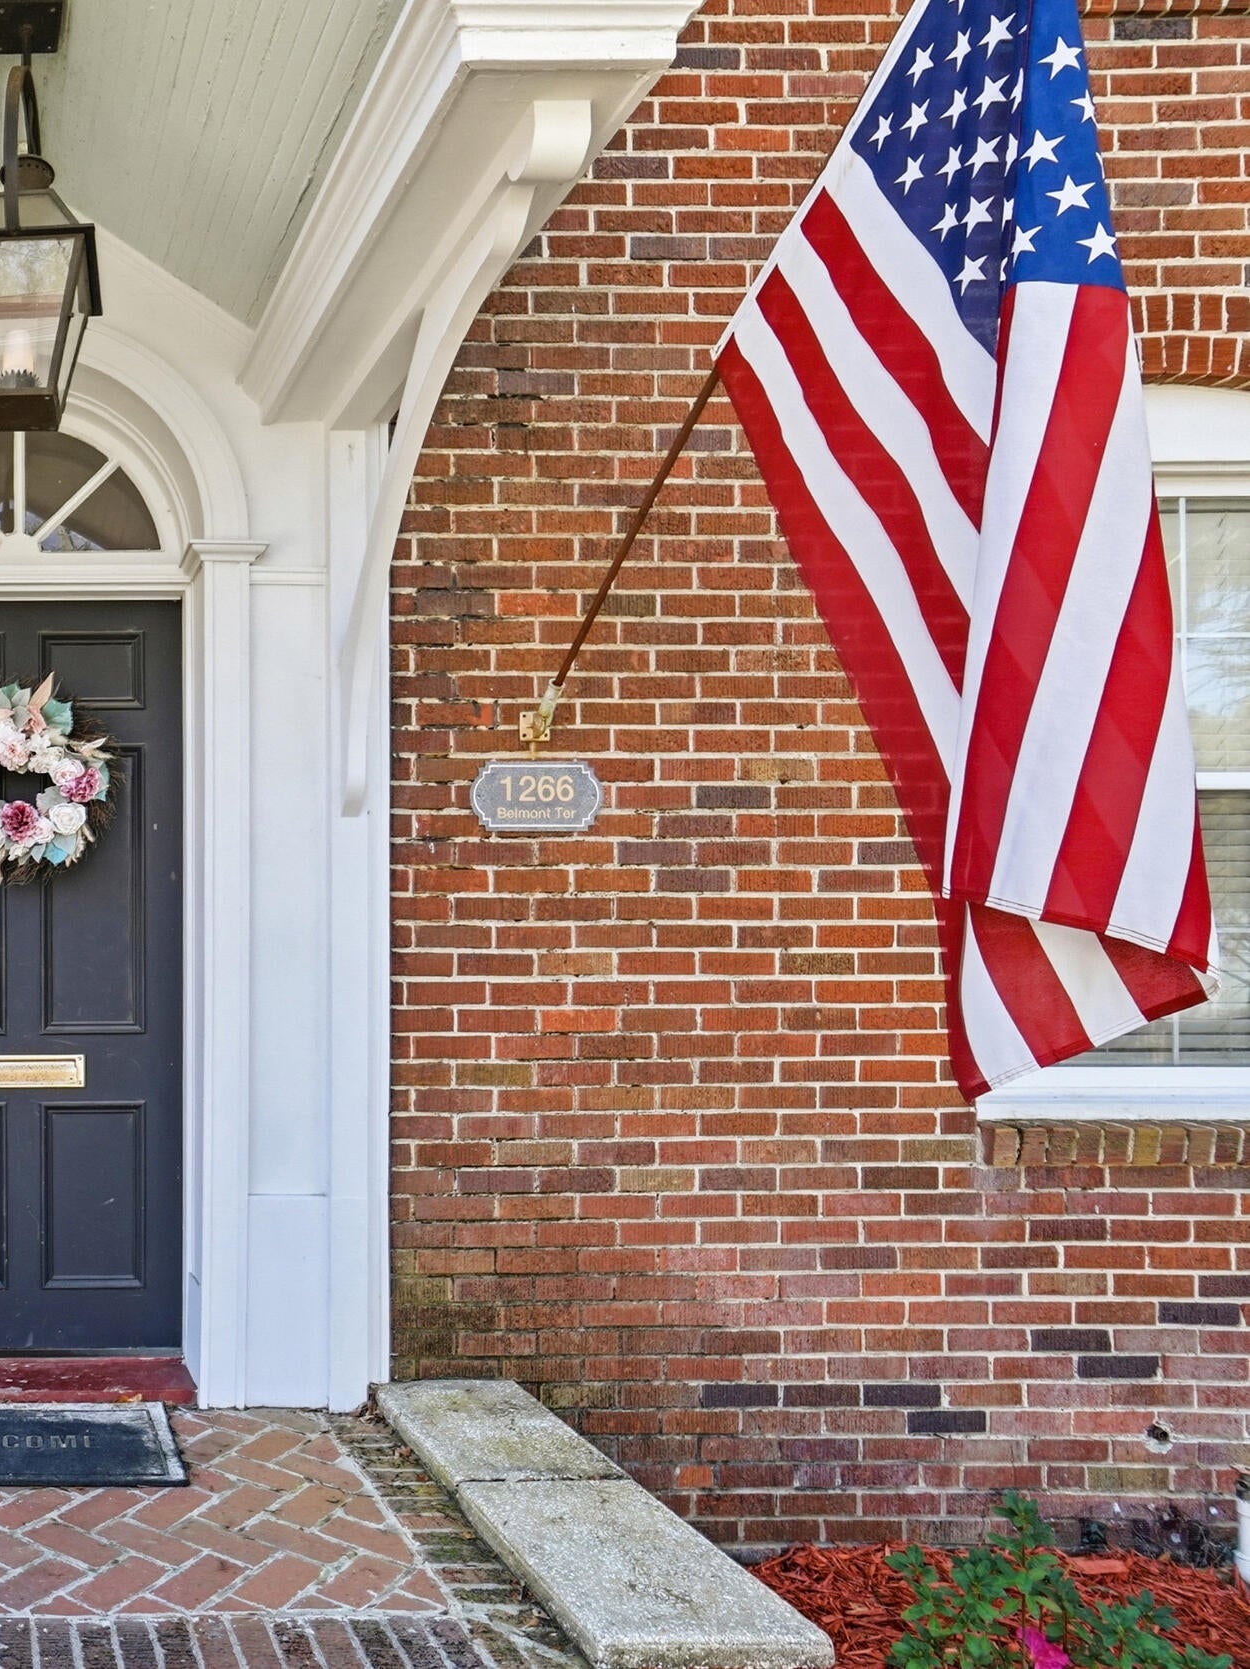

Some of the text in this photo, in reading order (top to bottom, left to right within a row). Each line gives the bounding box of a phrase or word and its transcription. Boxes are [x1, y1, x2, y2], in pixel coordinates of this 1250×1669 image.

[499, 775, 575, 802] 1266
[497, 806, 577, 819] Belmont Ter
